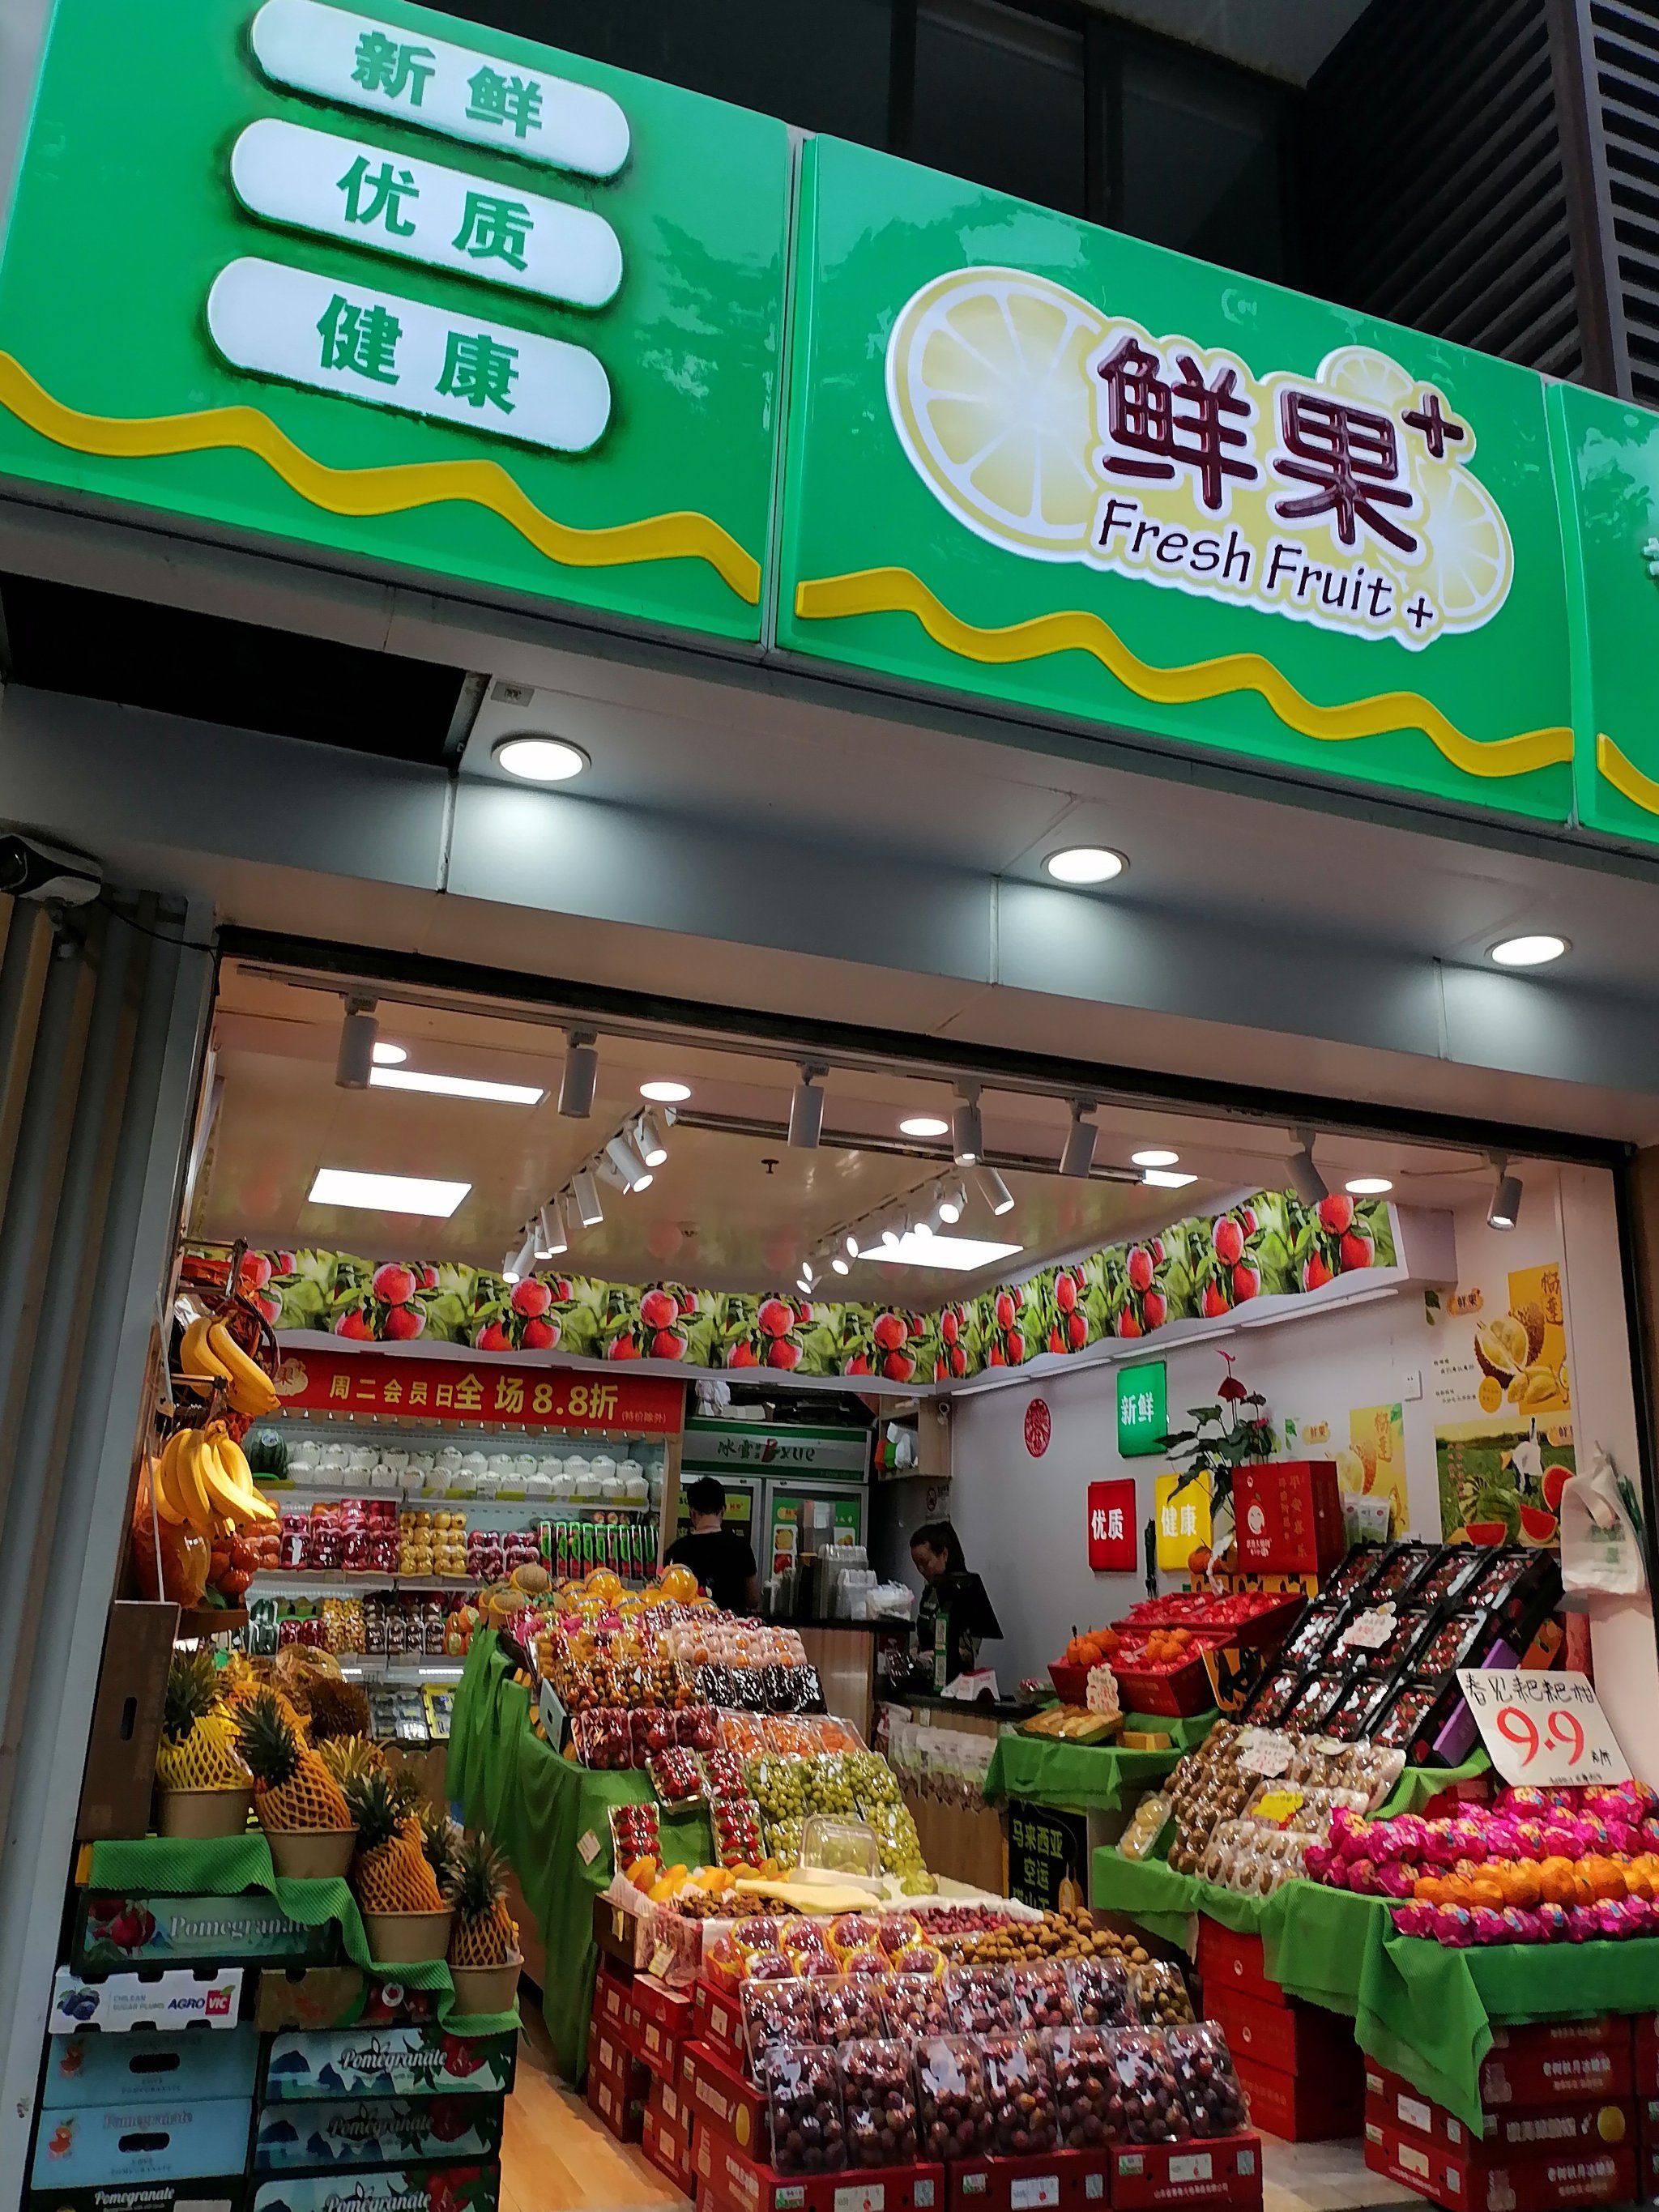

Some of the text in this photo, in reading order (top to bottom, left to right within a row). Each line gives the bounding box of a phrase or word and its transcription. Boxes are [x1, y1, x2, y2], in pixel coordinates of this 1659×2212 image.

[350, 30, 544, 139] 新鲜
[335, 154, 534, 272] 优质
[315, 293, 520, 415] 健康
[1098, 498, 1252, 583] Fresh
[1266, 544, 1392, 618] Fruit
[1120, 1392, 1155, 1426] 新鲜
[1091, 1508, 1124, 1541] 优质
[1160, 1503, 1197, 1537] 健康
[1496, 1706, 1585, 1767] 9.9
[1012, 1818, 1064, 1860] 马来西亚
[168, 1997, 205, 2010] AGRO
[208, 1997, 228, 2010] VIC
